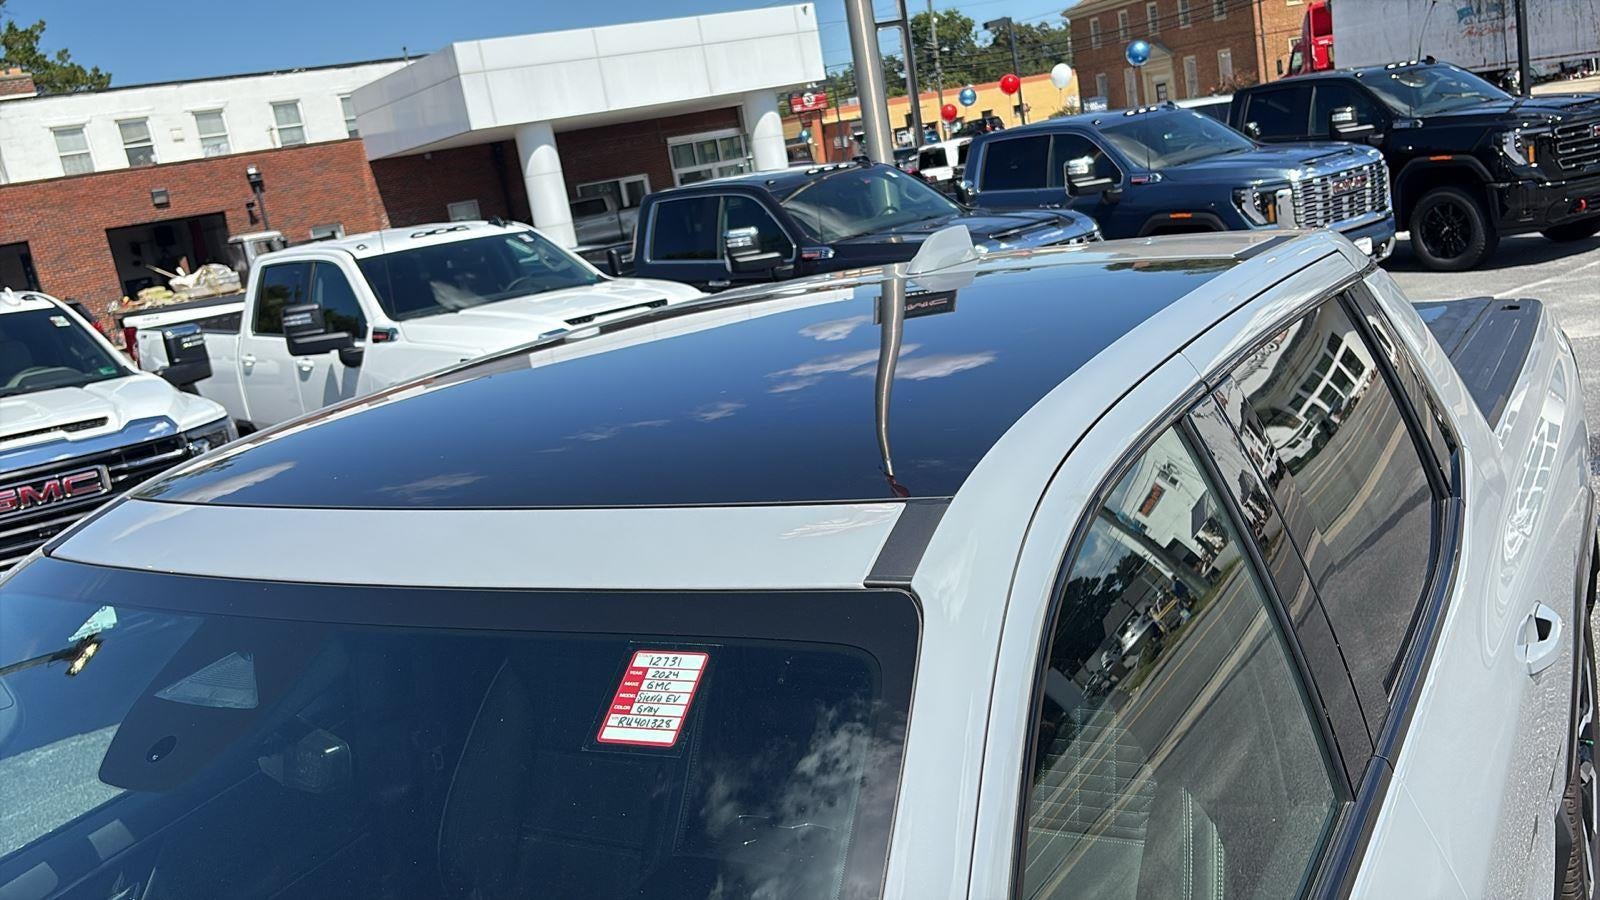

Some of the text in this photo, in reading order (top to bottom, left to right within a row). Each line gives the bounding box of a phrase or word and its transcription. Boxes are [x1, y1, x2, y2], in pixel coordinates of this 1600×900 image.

[649, 656, 682, 667] 12731
[652, 670, 680, 679] 2024
[647, 681, 672, 690] GMC
[666, 694, 681, 703] EV
[637, 704, 660, 715] Gray
